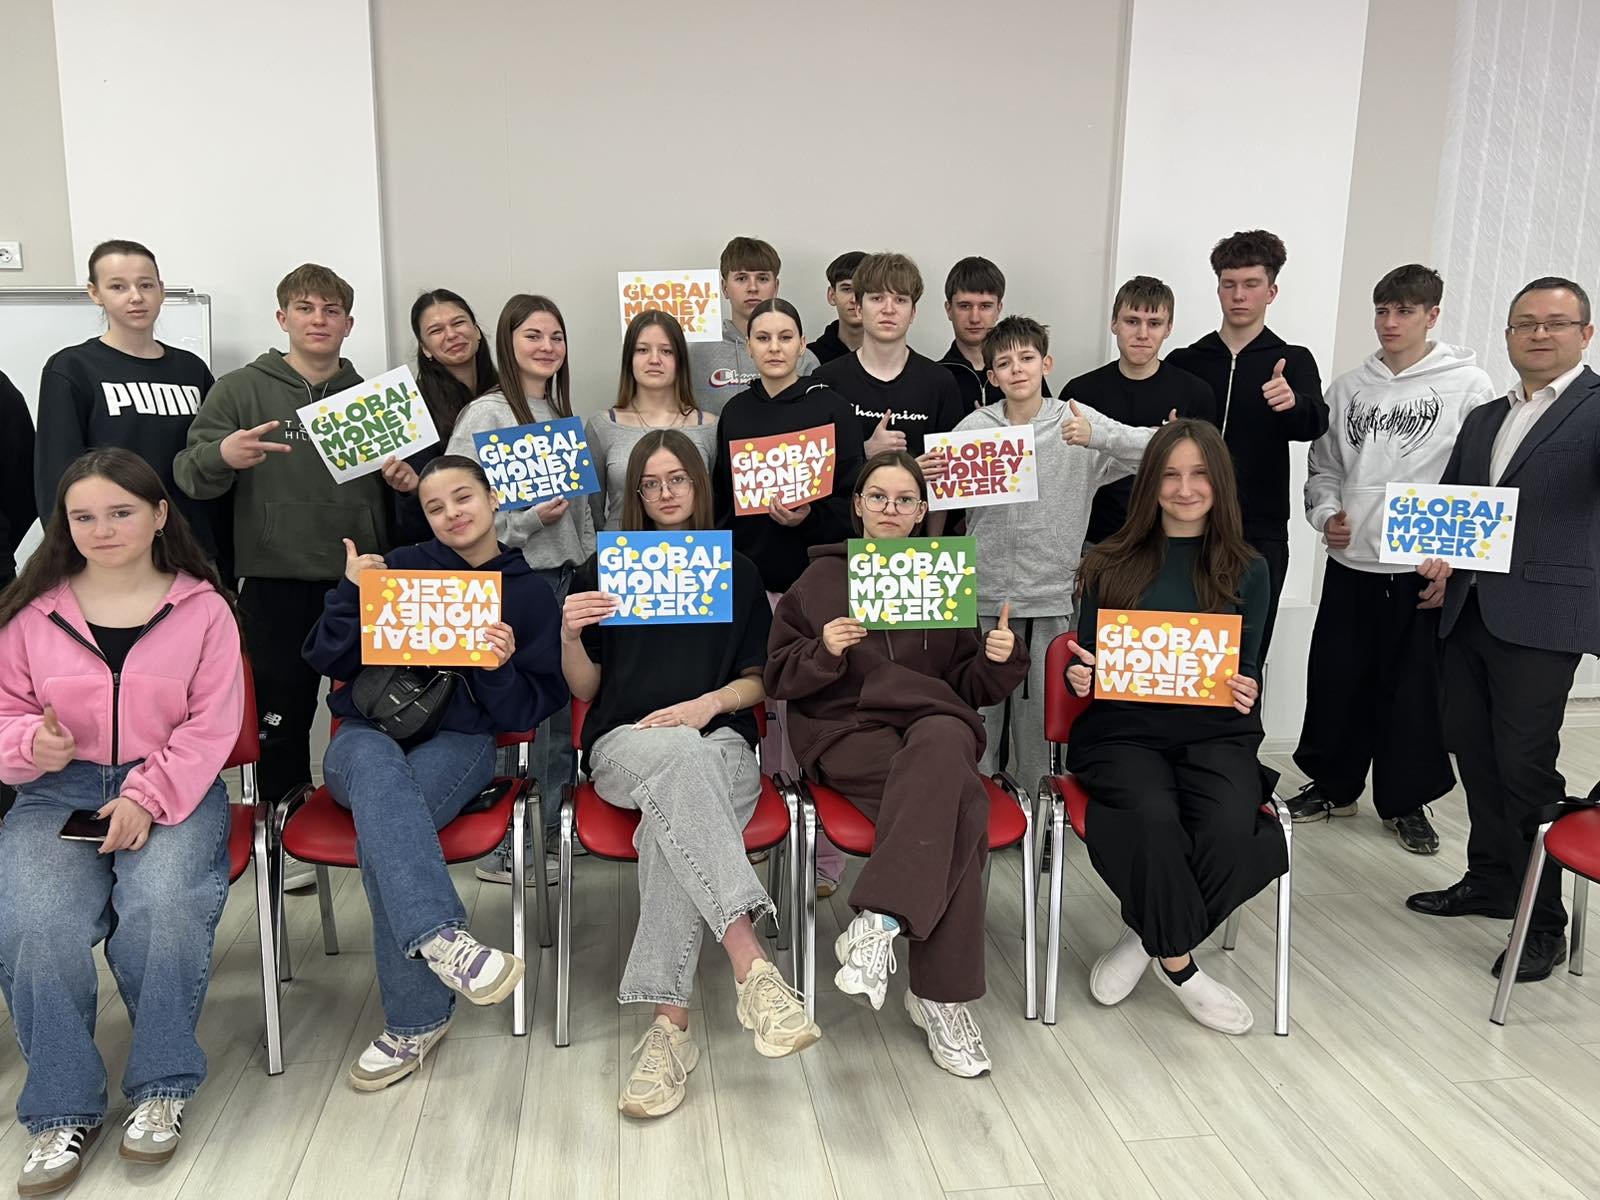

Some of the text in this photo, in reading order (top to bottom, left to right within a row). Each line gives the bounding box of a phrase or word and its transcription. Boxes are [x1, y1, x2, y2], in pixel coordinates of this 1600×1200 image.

[623, 282, 718, 301] GLOBAL
[101, 382, 201, 416] PUMA
[311, 382, 418, 436] GLOBAL
[319, 401, 412, 455] MONEY
[327, 425, 412, 471] WEEK
[479, 430, 587, 465] GLOBAL
[732, 437, 836, 471] GLOBAL
[484, 449, 579, 486] MONEY
[733, 457, 826, 490] MONEY
[490, 472, 572, 505] WEEK
[734, 479, 812, 509] WEEK
[930, 475, 1009, 500] WEEK
[1389, 496, 1513, 521] GLOBAL
[1387, 516, 1500, 539] MONEY
[599, 545, 732, 571] GLOBAL
[1386, 533, 1477, 558] WEEK
[849, 551, 976, 577] GLOBAL
[396, 577, 500, 603] WEEK
[600, 569, 720, 594] MONEY
[850, 574, 964, 599] MONEY
[375, 602, 499, 627] MONEY
[849, 597, 945, 623] WEEK
[1098, 623, 1240, 655] GLOBAL
[1097, 648, 1225, 677] MONEY
[1096, 669, 1201, 698] WEEK
